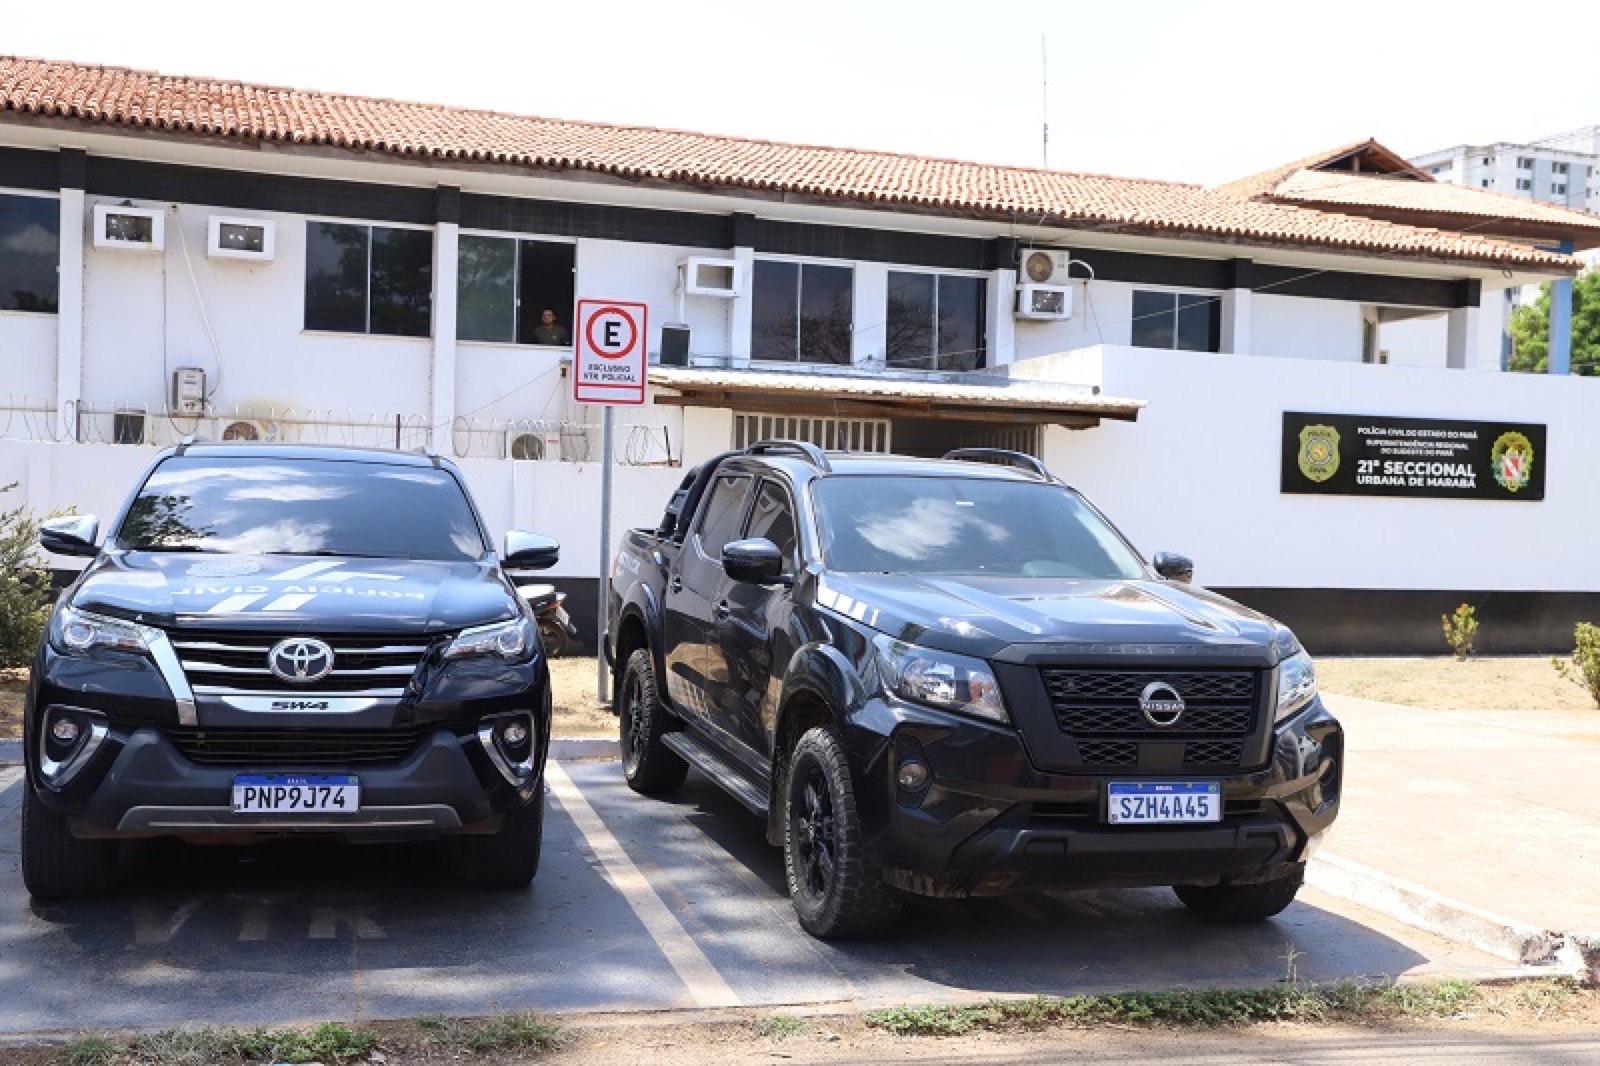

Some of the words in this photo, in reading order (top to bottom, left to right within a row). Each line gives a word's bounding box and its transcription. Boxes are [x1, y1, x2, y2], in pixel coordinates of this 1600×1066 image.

[605, 322, 621, 346] E
[588, 363, 630, 373] EXCLUSIVO
[602, 374, 636, 383] POLICIAL
[1357, 425, 1387, 435] POLÍCIA
[1384, 461, 1476, 477] SECCIONAL
[1356, 475, 1406, 486] URBANA
[1408, 477, 1424, 486] DE
[271, 701, 329, 710] SW4
[1141, 703, 1185, 711] NISSAN
[243, 787, 346, 809] PNP9J74
[1120, 796, 1209, 819] SZH4A45
